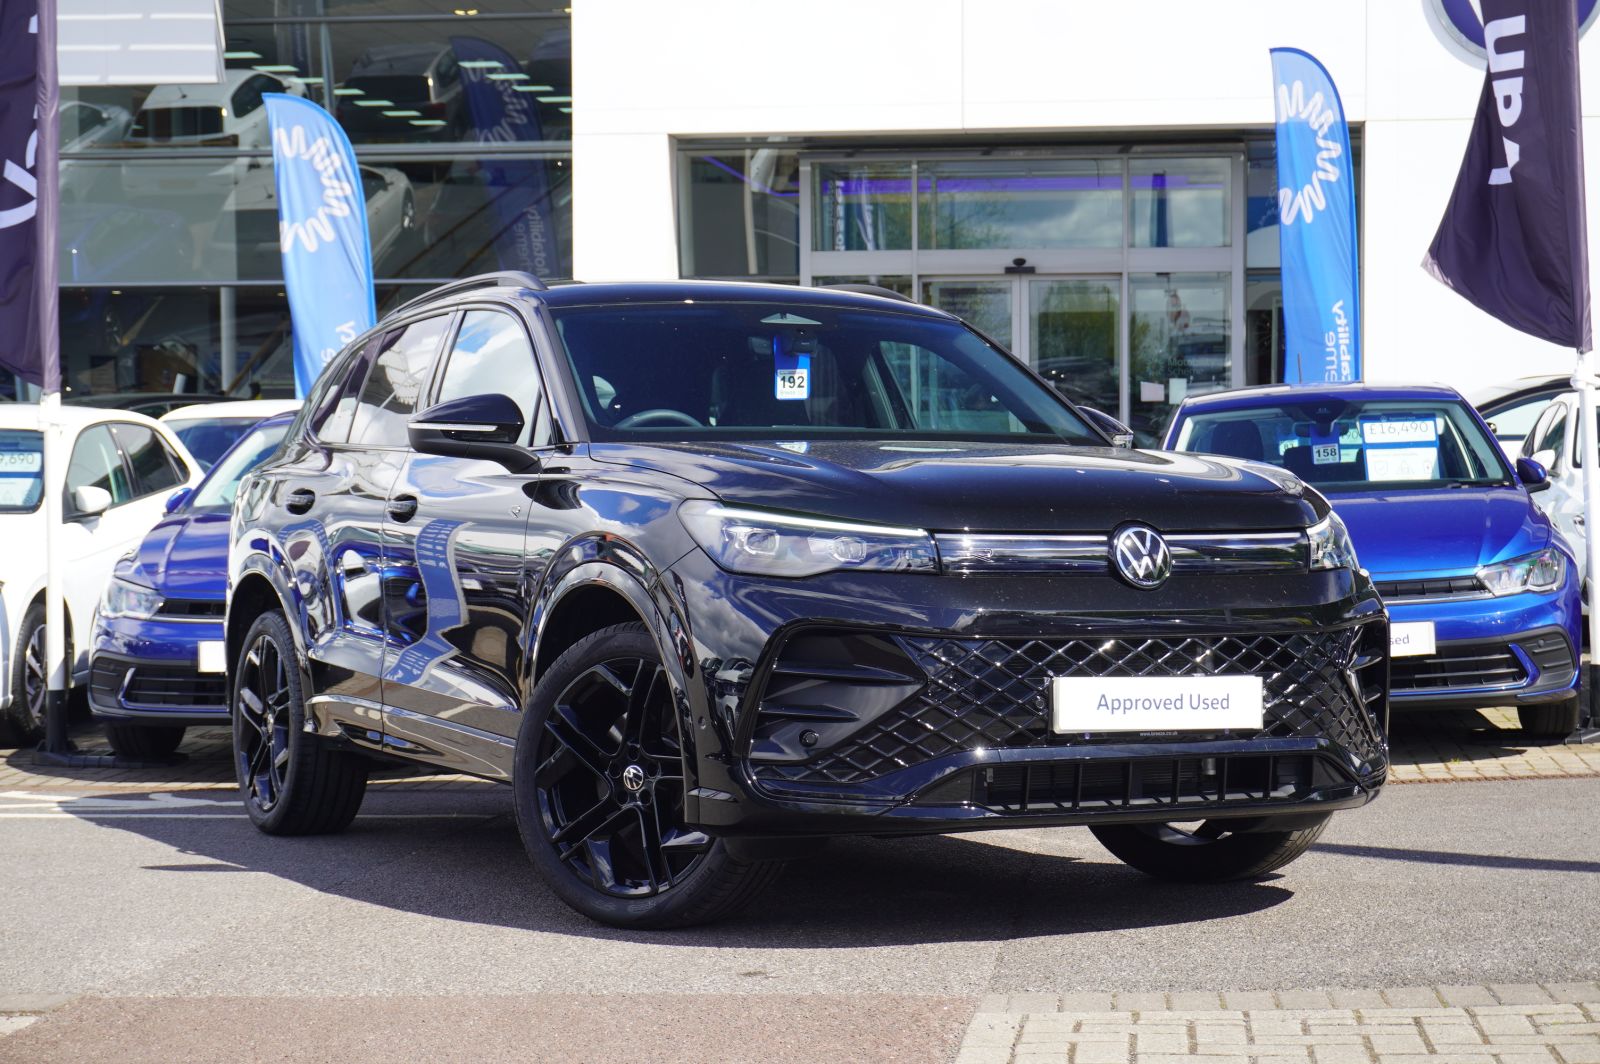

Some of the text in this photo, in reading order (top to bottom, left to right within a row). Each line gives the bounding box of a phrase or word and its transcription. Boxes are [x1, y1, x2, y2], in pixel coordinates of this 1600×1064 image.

[780, 375, 805, 389] 192
[1369, 422, 1429, 436] £16,490
[1315, 447, 1337, 458] 158
[1389, 633, 1410, 645] sed
[1096, 693, 1230, 715] Approved Used
